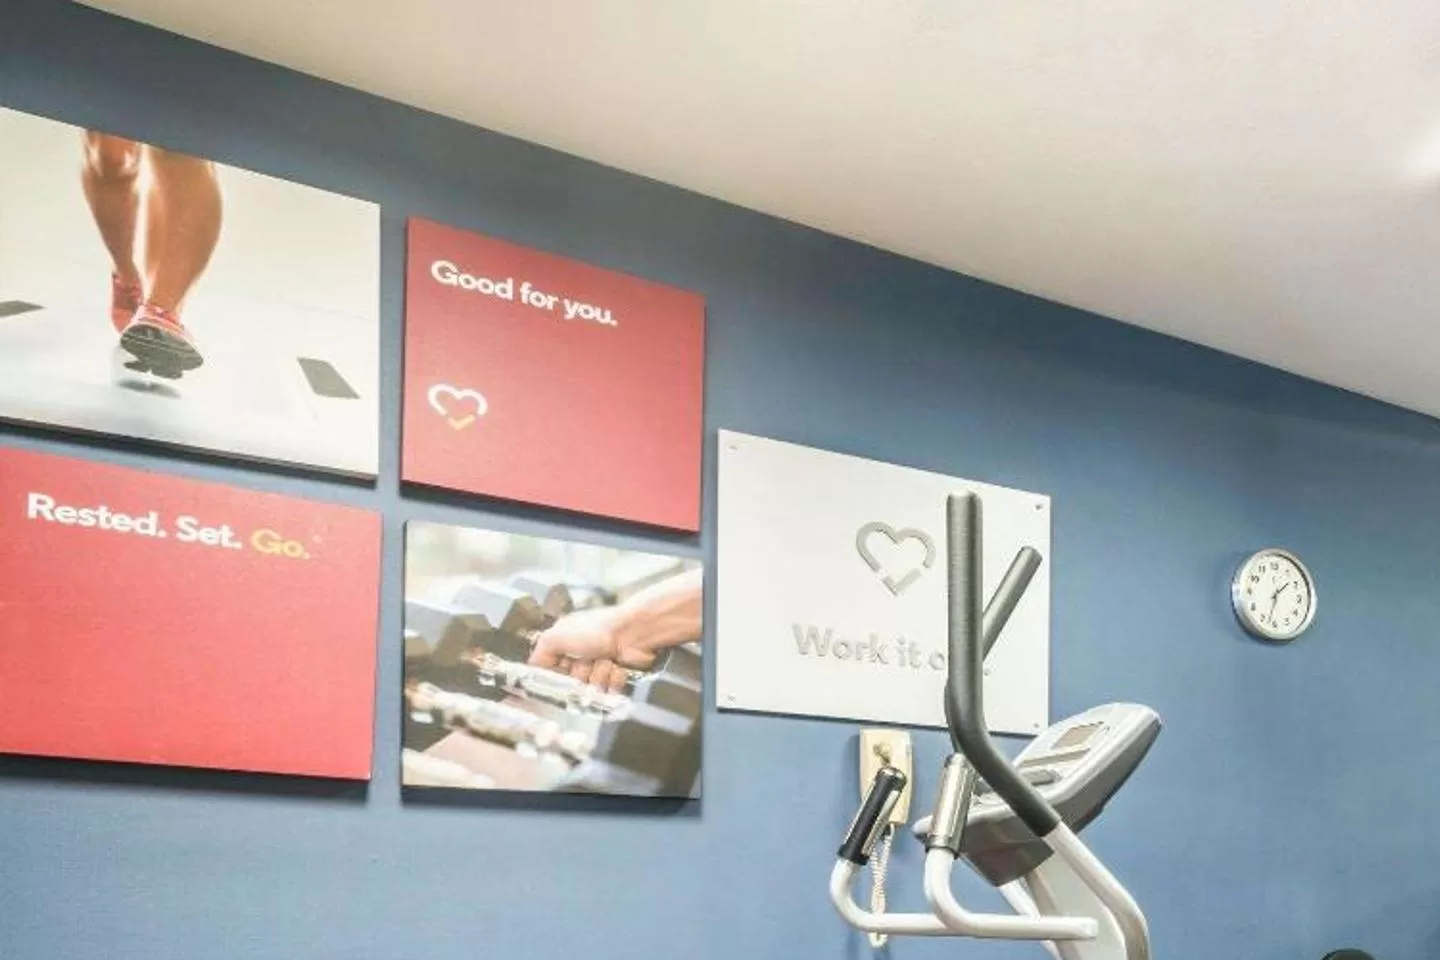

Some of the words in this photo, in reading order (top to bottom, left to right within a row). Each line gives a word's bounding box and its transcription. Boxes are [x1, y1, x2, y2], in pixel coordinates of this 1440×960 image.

[431, 259, 514, 301] Good
[519, 281, 559, 310] for
[563, 297, 618, 327] you.
[27, 491, 167, 538] Rested.
[174, 515, 243, 550] Set.
[250, 528, 310, 560] Go.
[791, 622, 891, 665] Work
[896, 636, 922, 669] it
